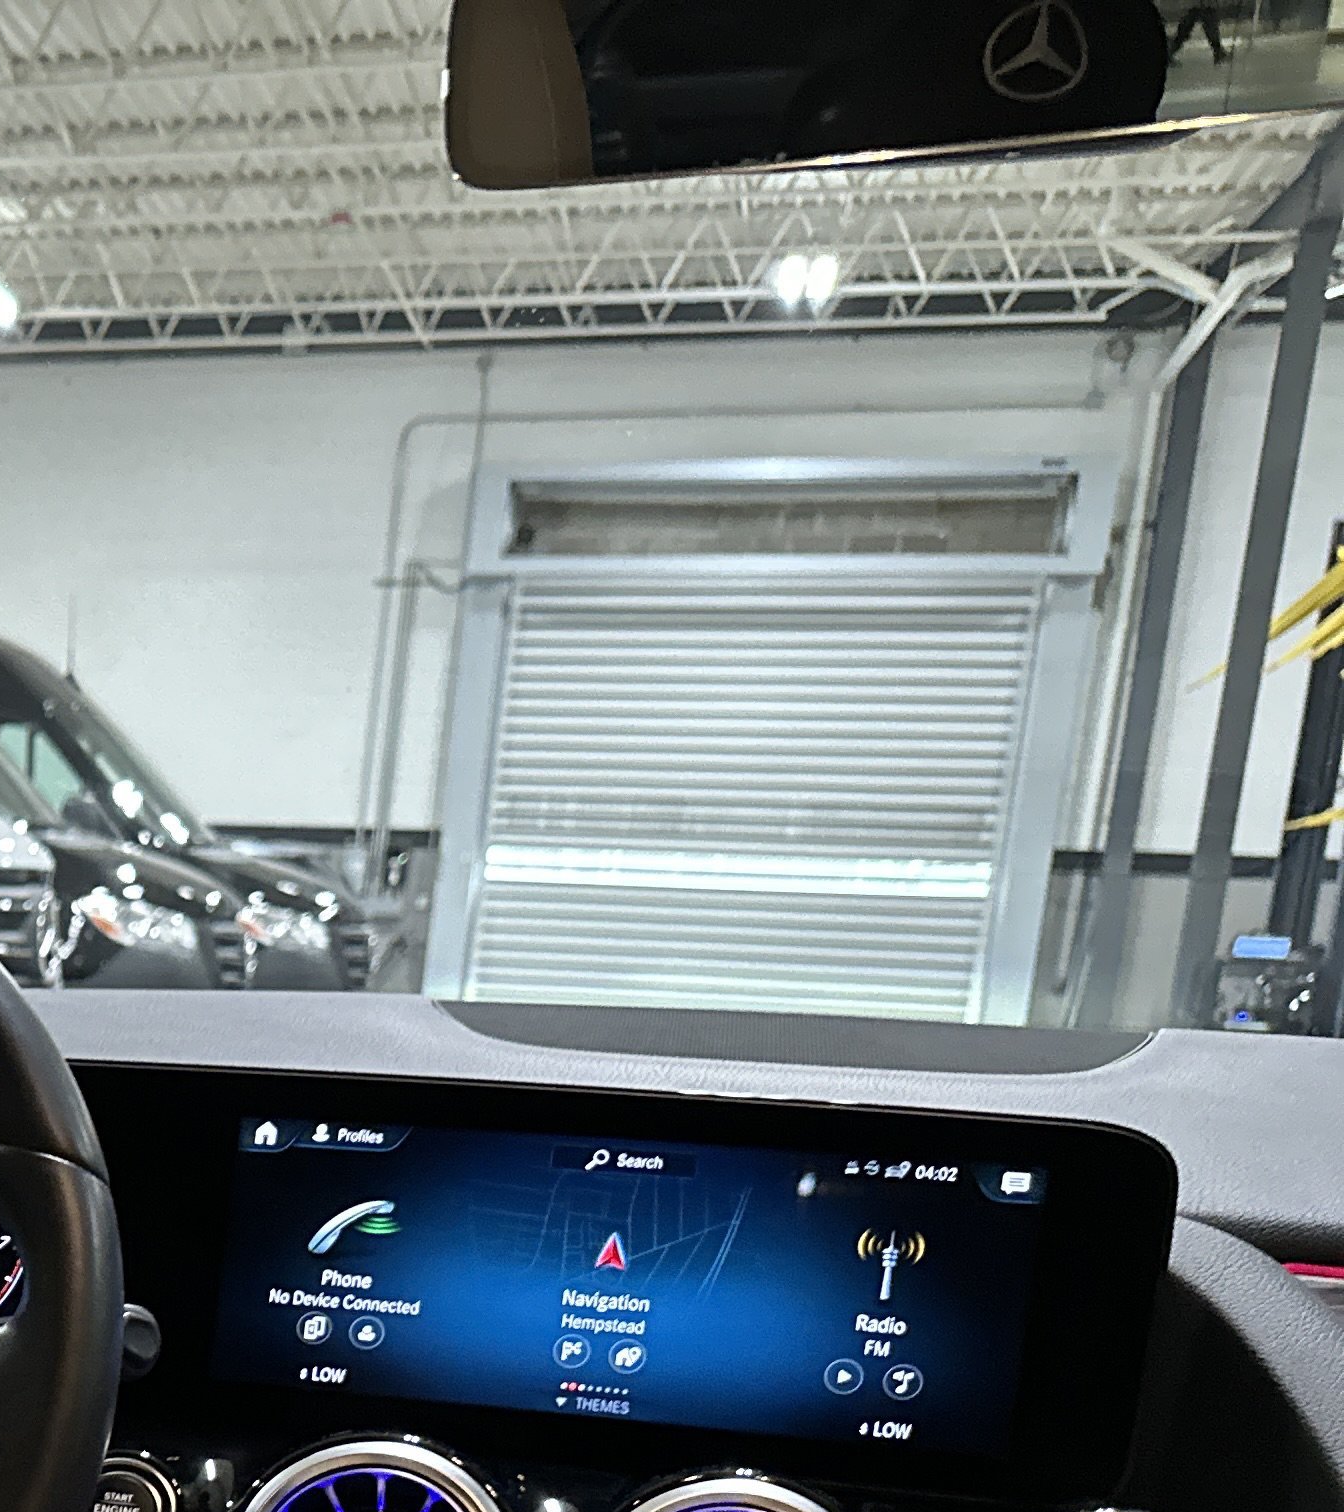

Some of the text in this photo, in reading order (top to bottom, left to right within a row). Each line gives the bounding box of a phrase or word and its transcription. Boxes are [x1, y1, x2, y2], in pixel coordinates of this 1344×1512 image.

[337, 1127, 384, 1145] Profiles
[616, 1152, 664, 1170] Search
[914, 1164, 959, 1183] 04:02
[320, 1268, 373, 1290] Phone
[268, 1287, 422, 1316] No Device Connected
[561, 1288, 651, 1314] Navigation
[560, 1313, 646, 1336] Hempstead
[855, 1313, 907, 1336] Radio
[863, 1339, 892, 1358] FM
[312, 1366, 347, 1384] LOW
[575, 1396, 631, 1415] THEMES
[872, 1420, 913, 1440] LOW
[103, 1491, 134, 1502] START
